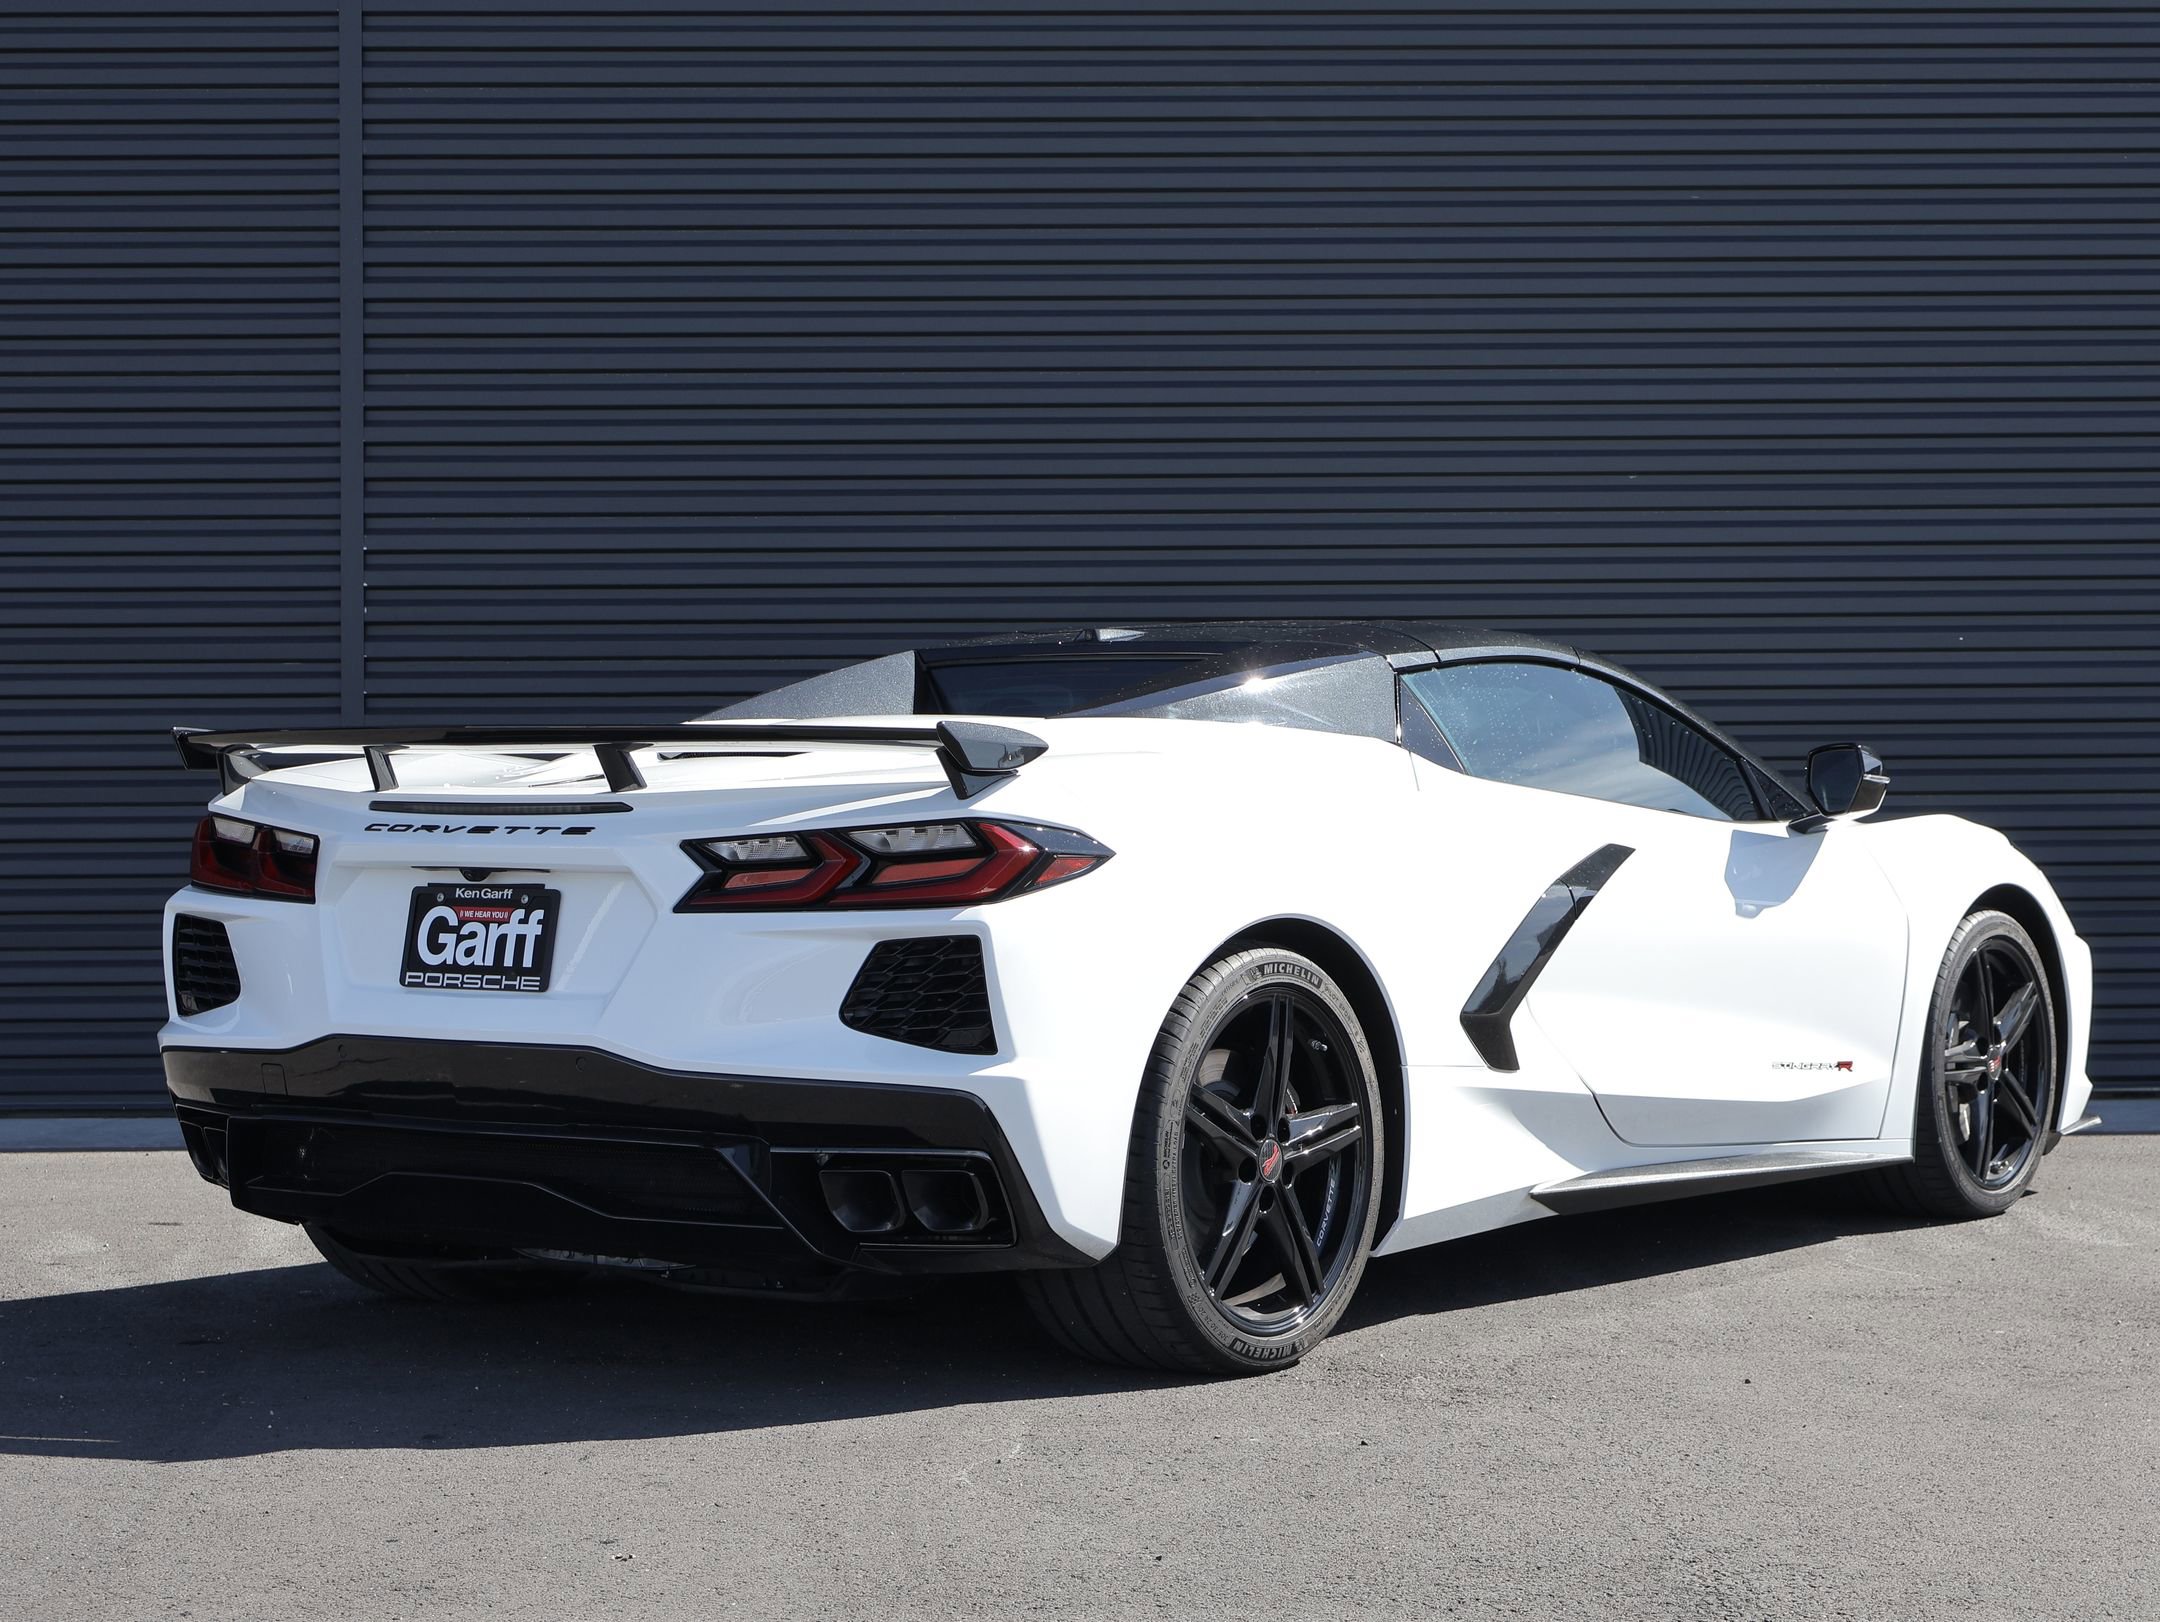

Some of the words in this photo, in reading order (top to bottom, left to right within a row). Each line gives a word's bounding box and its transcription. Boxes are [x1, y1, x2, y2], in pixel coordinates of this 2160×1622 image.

[364, 823, 595, 835] CORVETTE
[455, 887, 480, 899] Ken
[481, 888, 513, 900] Garff
[464, 910, 474, 919] WE
[474, 910, 490, 919] HEAR
[491, 911, 504, 919] YOU
[417, 905, 545, 968] Garff
[404, 971, 541, 991] PORSCHE
[1263, 962, 1320, 986] MICHELIN
[1316, 1178, 1336, 1247] CORVETTE
[1233, 1340, 1294, 1360] MICHELIN
